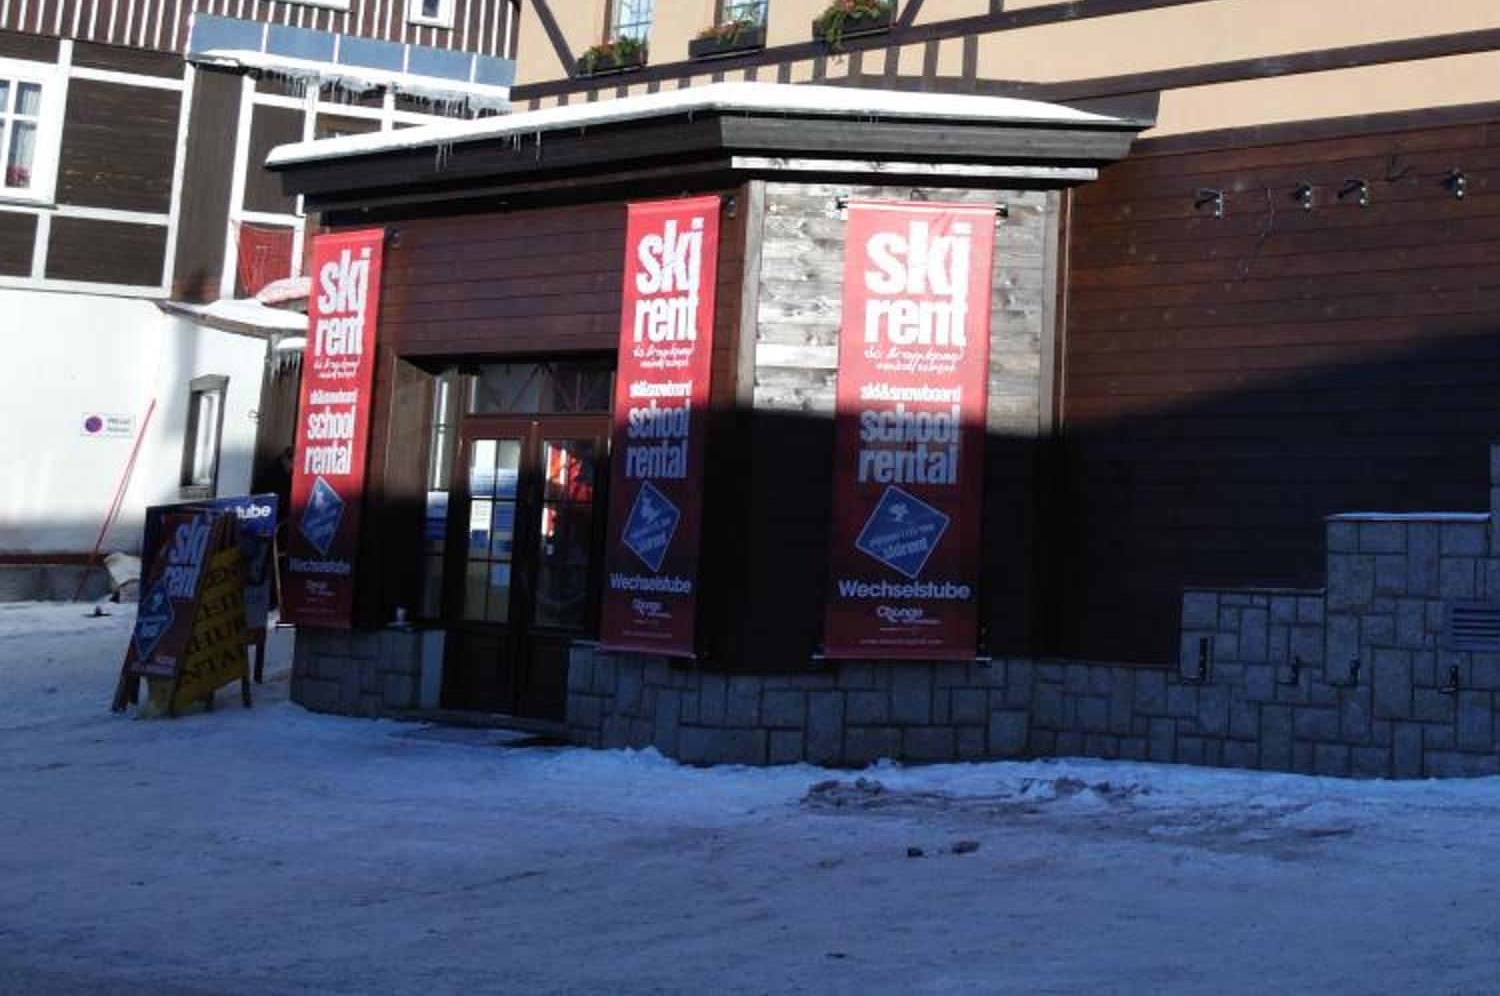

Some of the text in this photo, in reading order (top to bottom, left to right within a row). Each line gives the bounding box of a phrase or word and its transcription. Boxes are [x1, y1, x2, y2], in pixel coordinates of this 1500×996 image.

[636, 217, 705, 295] ski
[864, 220, 973, 296] ski
[318, 247, 374, 315] ski
[314, 315, 365, 357] rent
[633, 295, 699, 343] rent
[863, 298, 968, 347] rent
[307, 406, 355, 440] school
[627, 398, 690, 438] school
[860, 402, 961, 444] school
[303, 441, 353, 476] rental
[625, 440, 688, 479] rental
[857, 446, 959, 485] rental
[837, 578, 972, 600] Wechselstube
